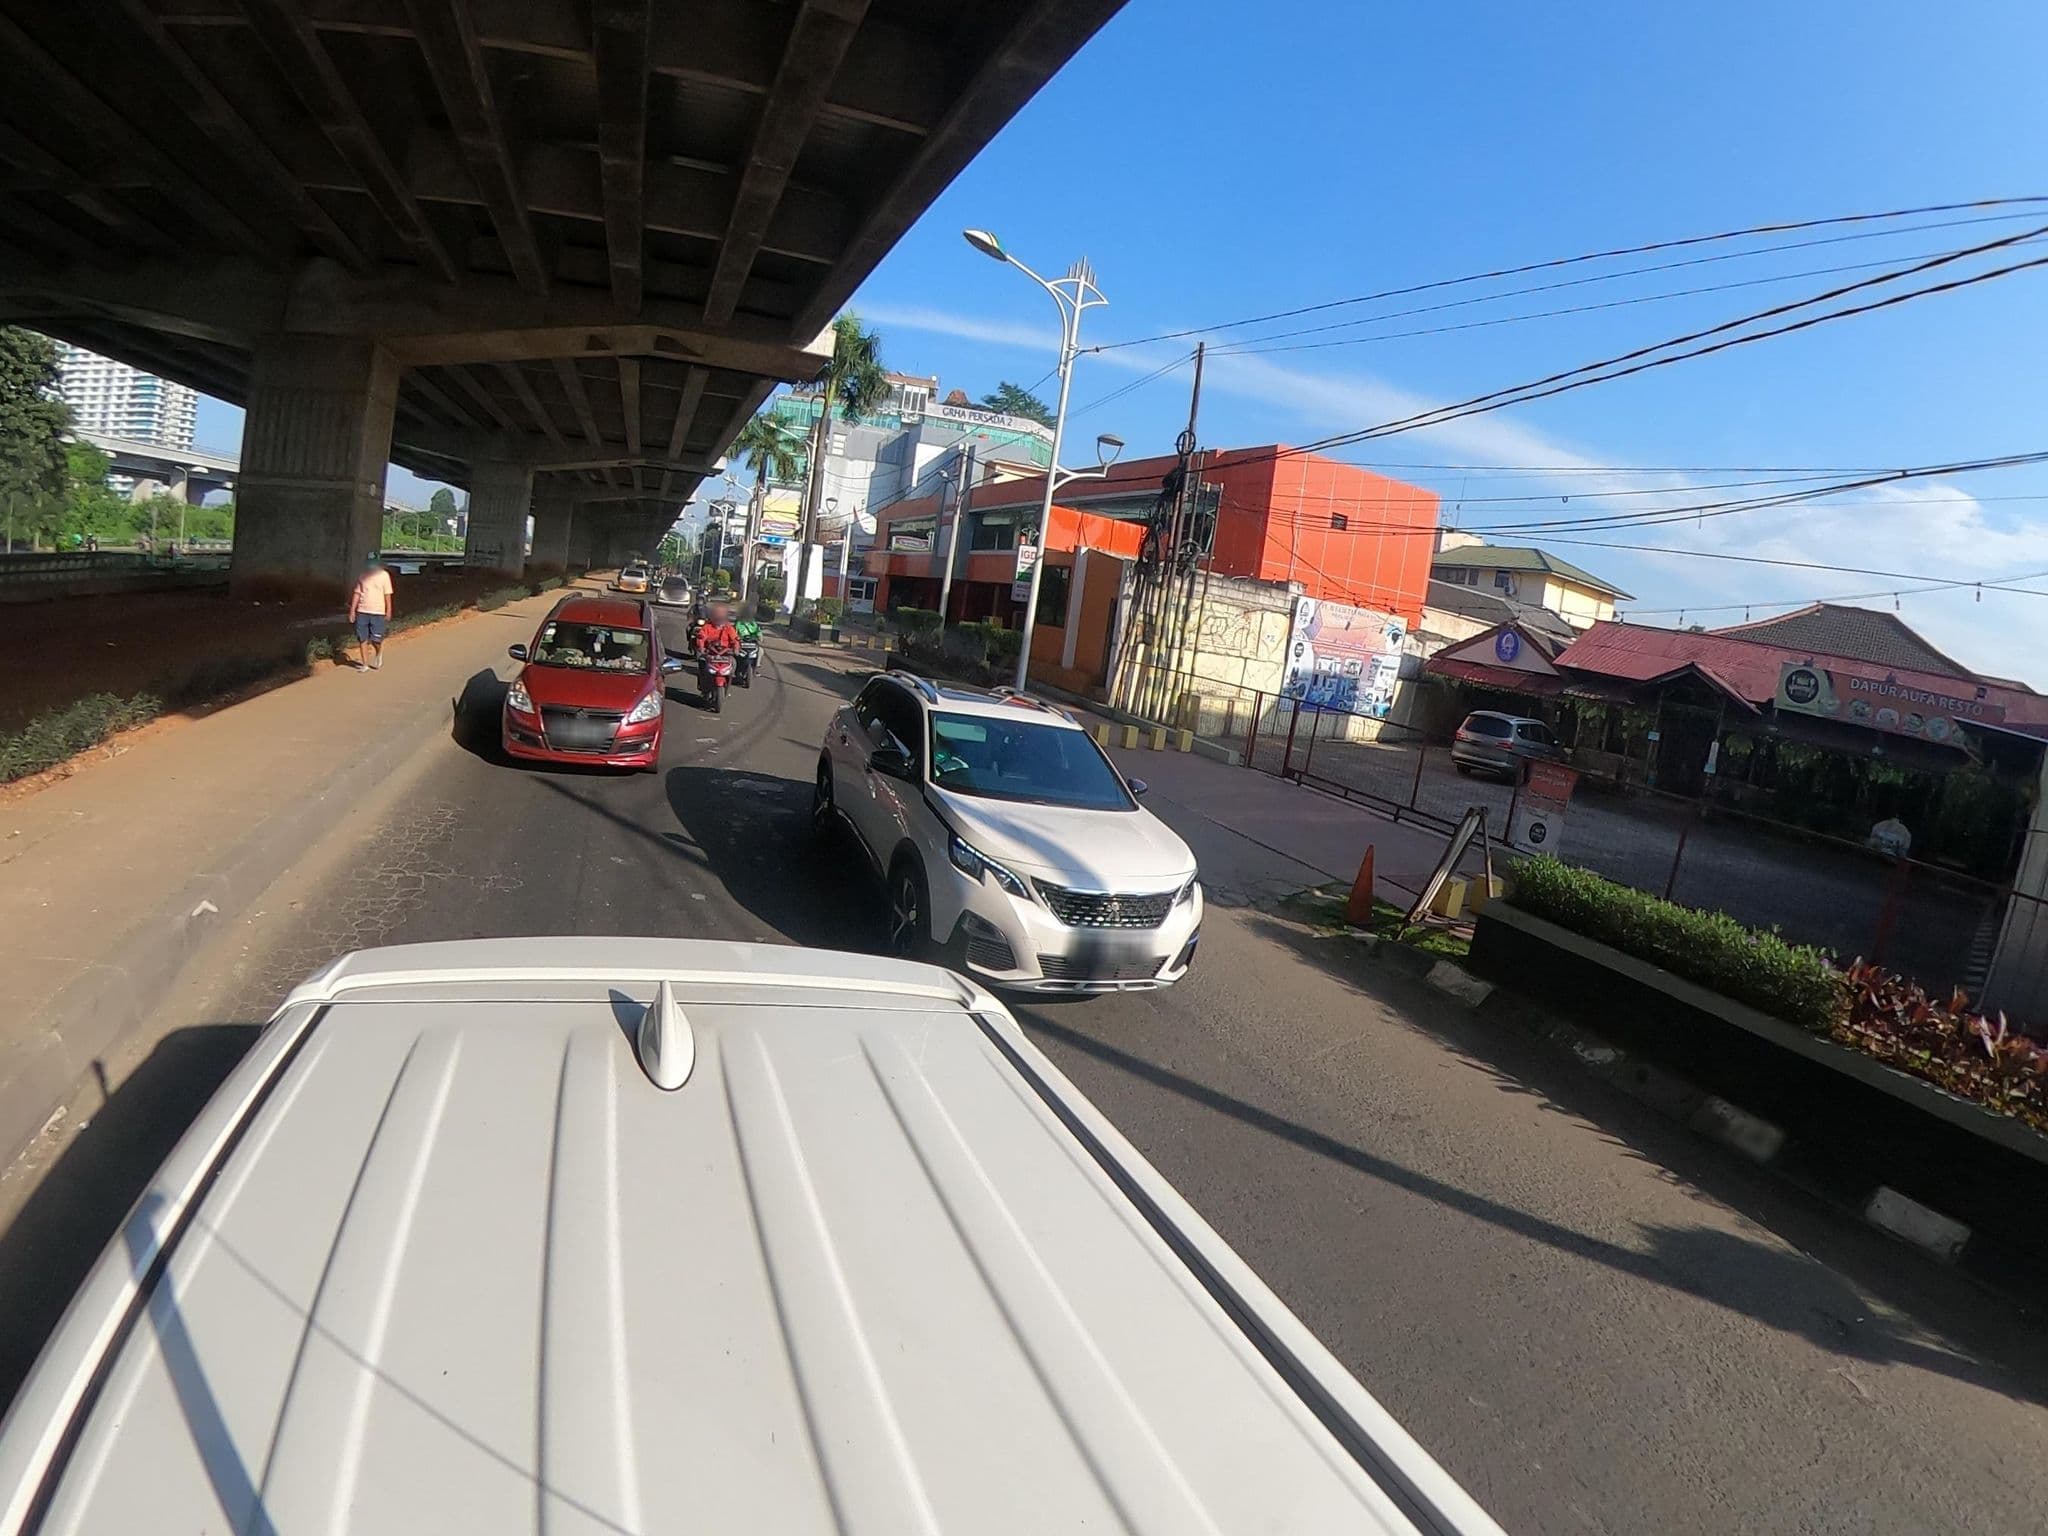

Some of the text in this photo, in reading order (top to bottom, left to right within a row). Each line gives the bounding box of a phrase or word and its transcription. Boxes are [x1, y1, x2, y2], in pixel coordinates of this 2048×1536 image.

[943, 407, 1013, 426] GRHA PERSADA 2
[1850, 678, 1983, 715] DAPUR AUFA RESTO
